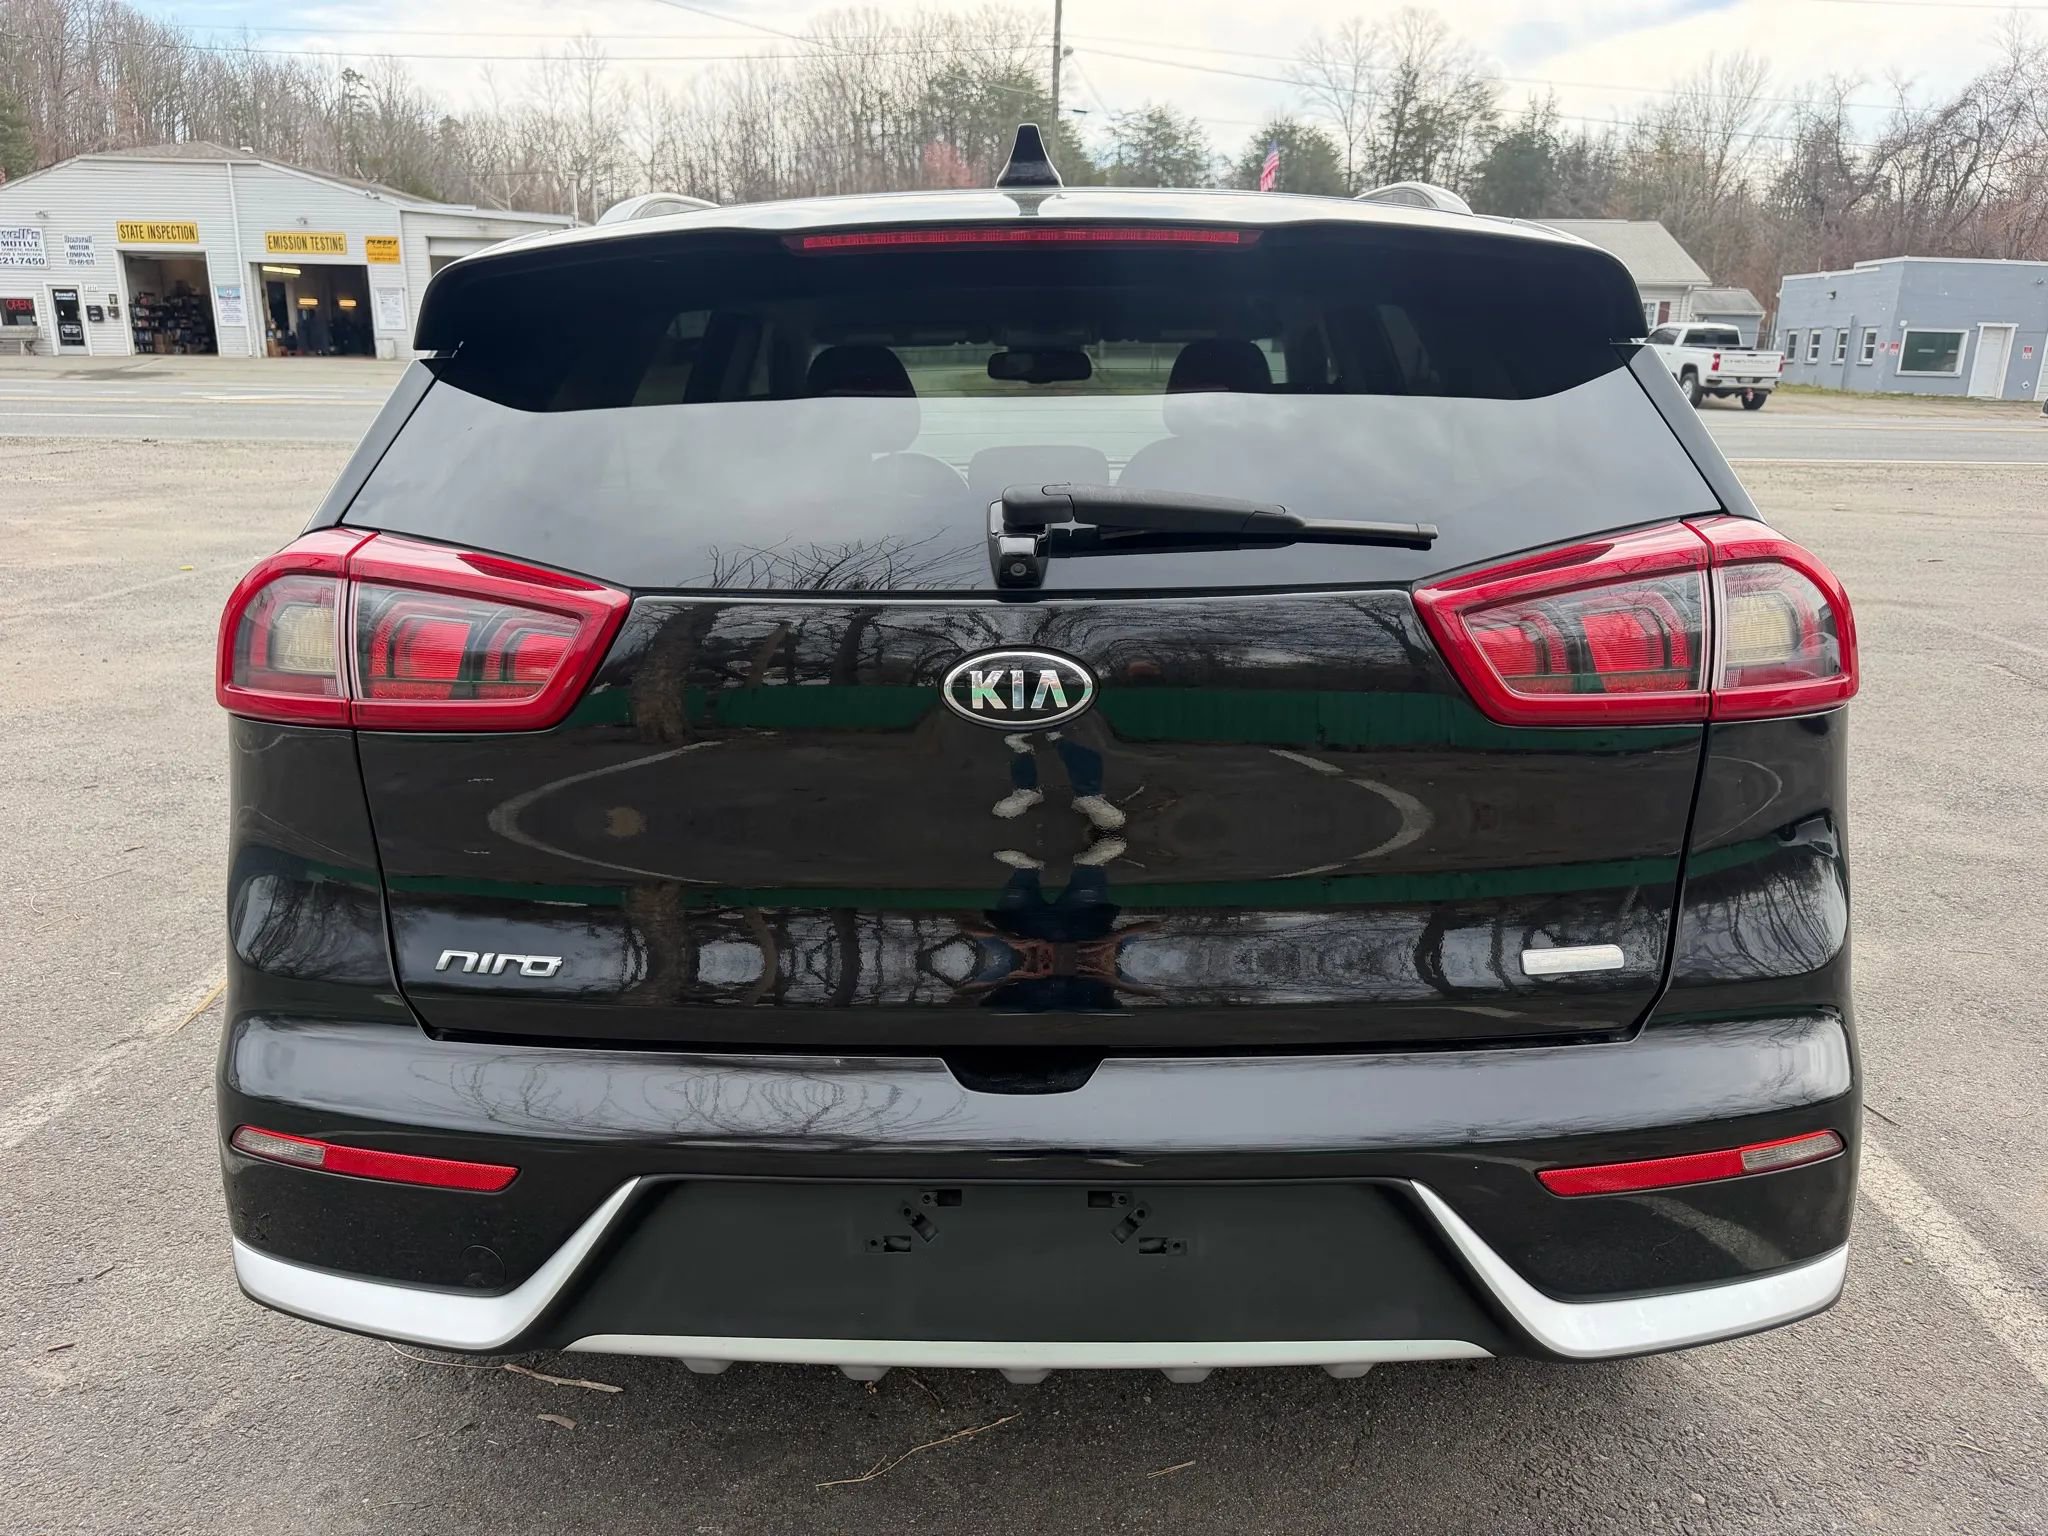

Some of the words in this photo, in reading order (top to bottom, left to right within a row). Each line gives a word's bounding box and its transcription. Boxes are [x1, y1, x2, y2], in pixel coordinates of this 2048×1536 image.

[120, 224, 145, 239] STATE
[147, 225, 196, 240] INSPECTION
[267, 235, 308, 250] EMISSION
[310, 236, 344, 251] TESTING
[6, 299, 33, 311] OPEN
[969, 669, 1069, 709] KIA
